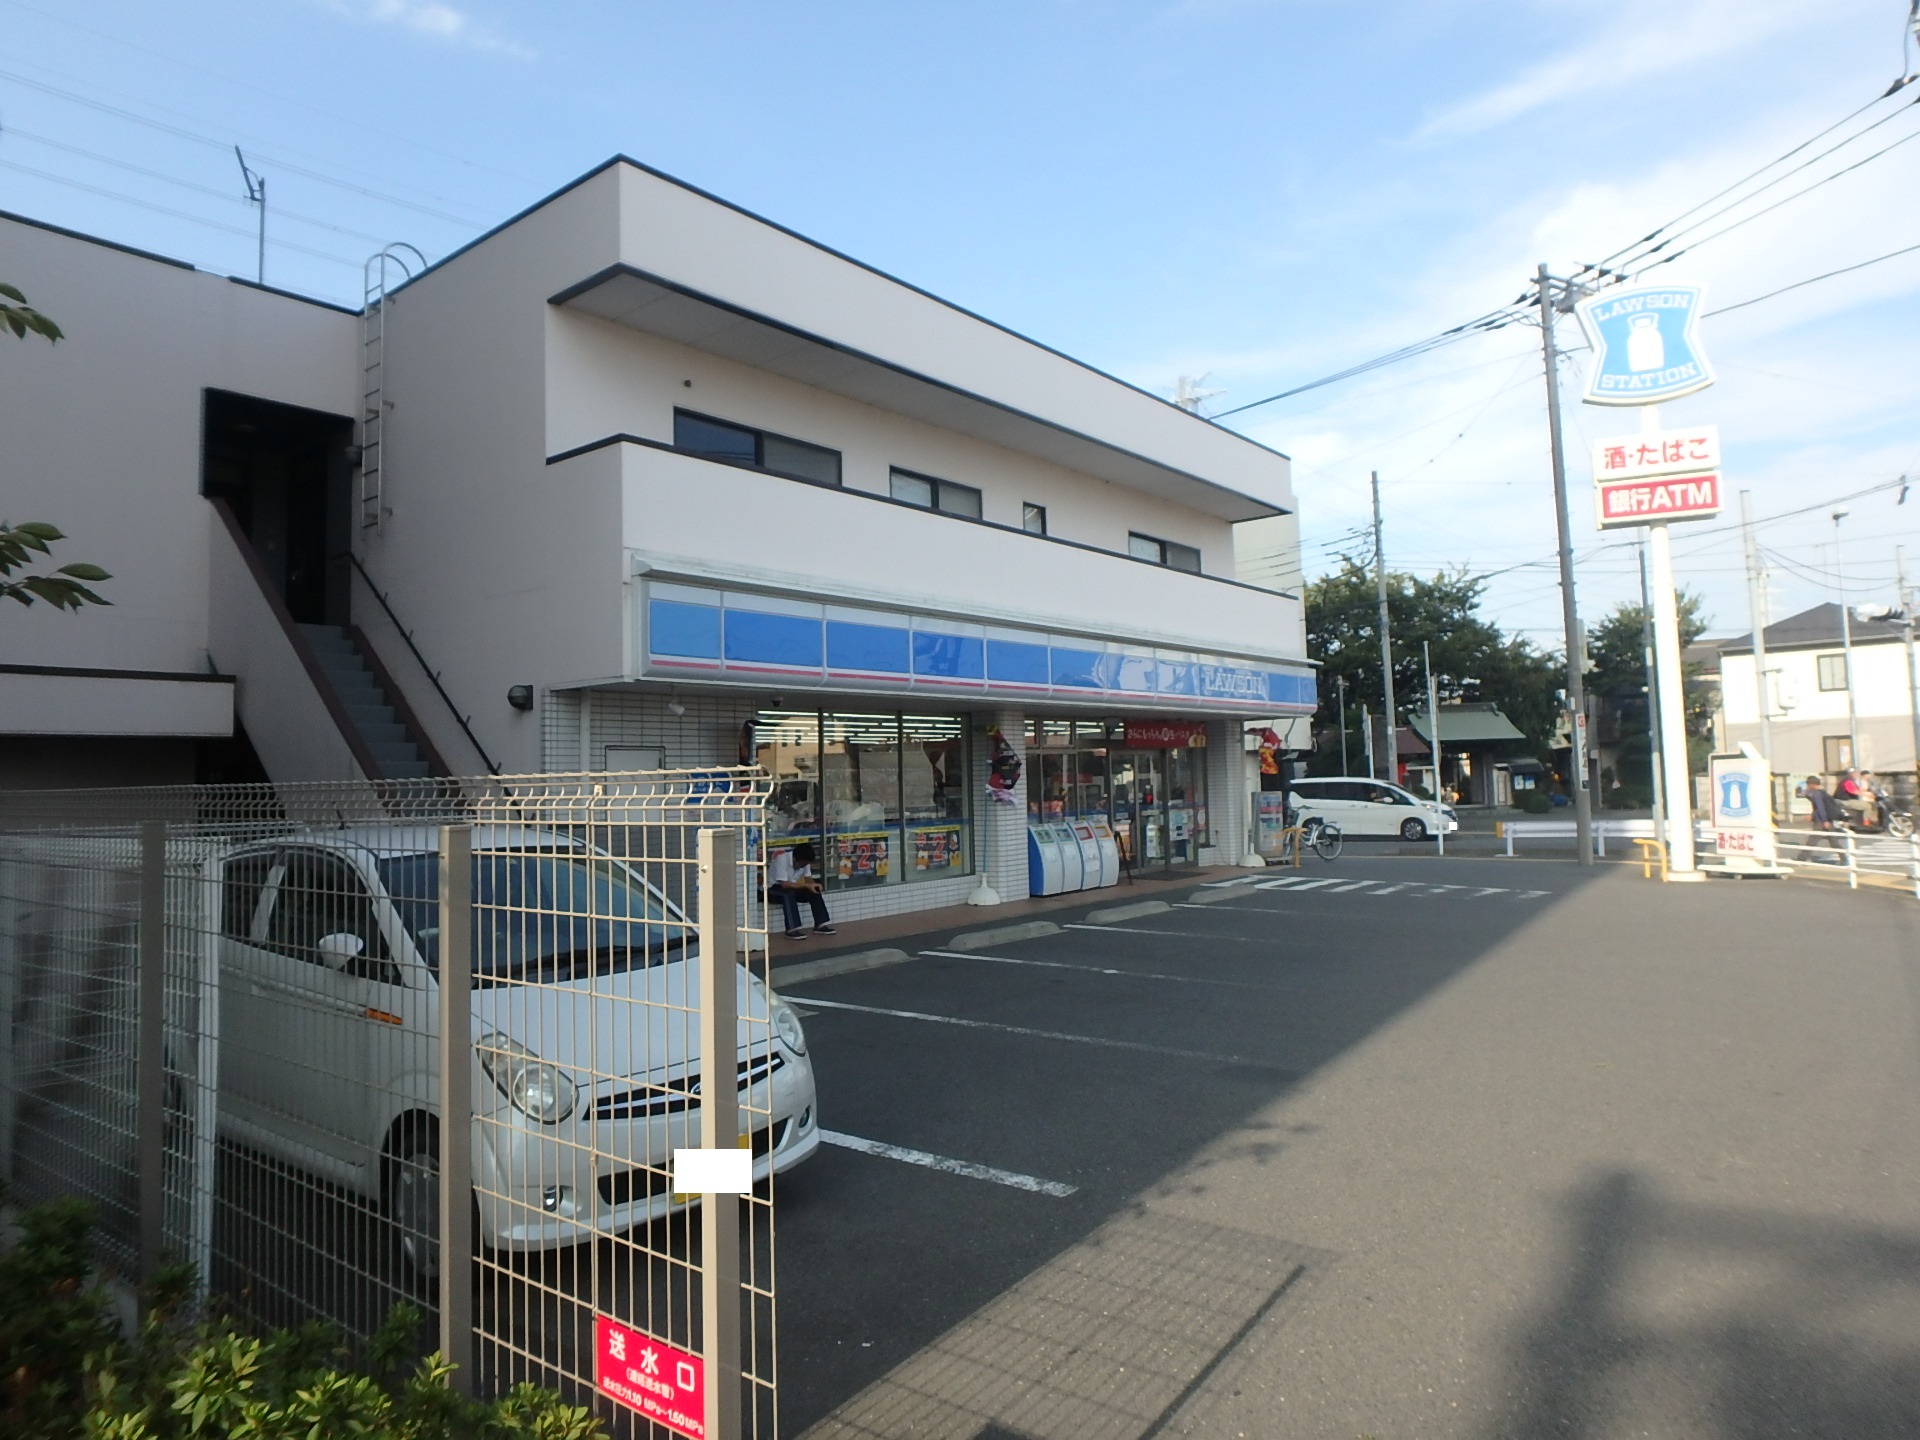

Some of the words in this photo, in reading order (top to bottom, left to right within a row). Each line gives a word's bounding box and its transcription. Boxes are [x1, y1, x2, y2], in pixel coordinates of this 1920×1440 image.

[1594, 293, 1690, 321] LAWSON
[1602, 362, 1697, 389] STATION
[1604, 437, 1710, 469] 酒・たばこ
[1609, 481, 1712, 513] 銀行ATM
[1205, 672, 1262, 694] LAWSON
